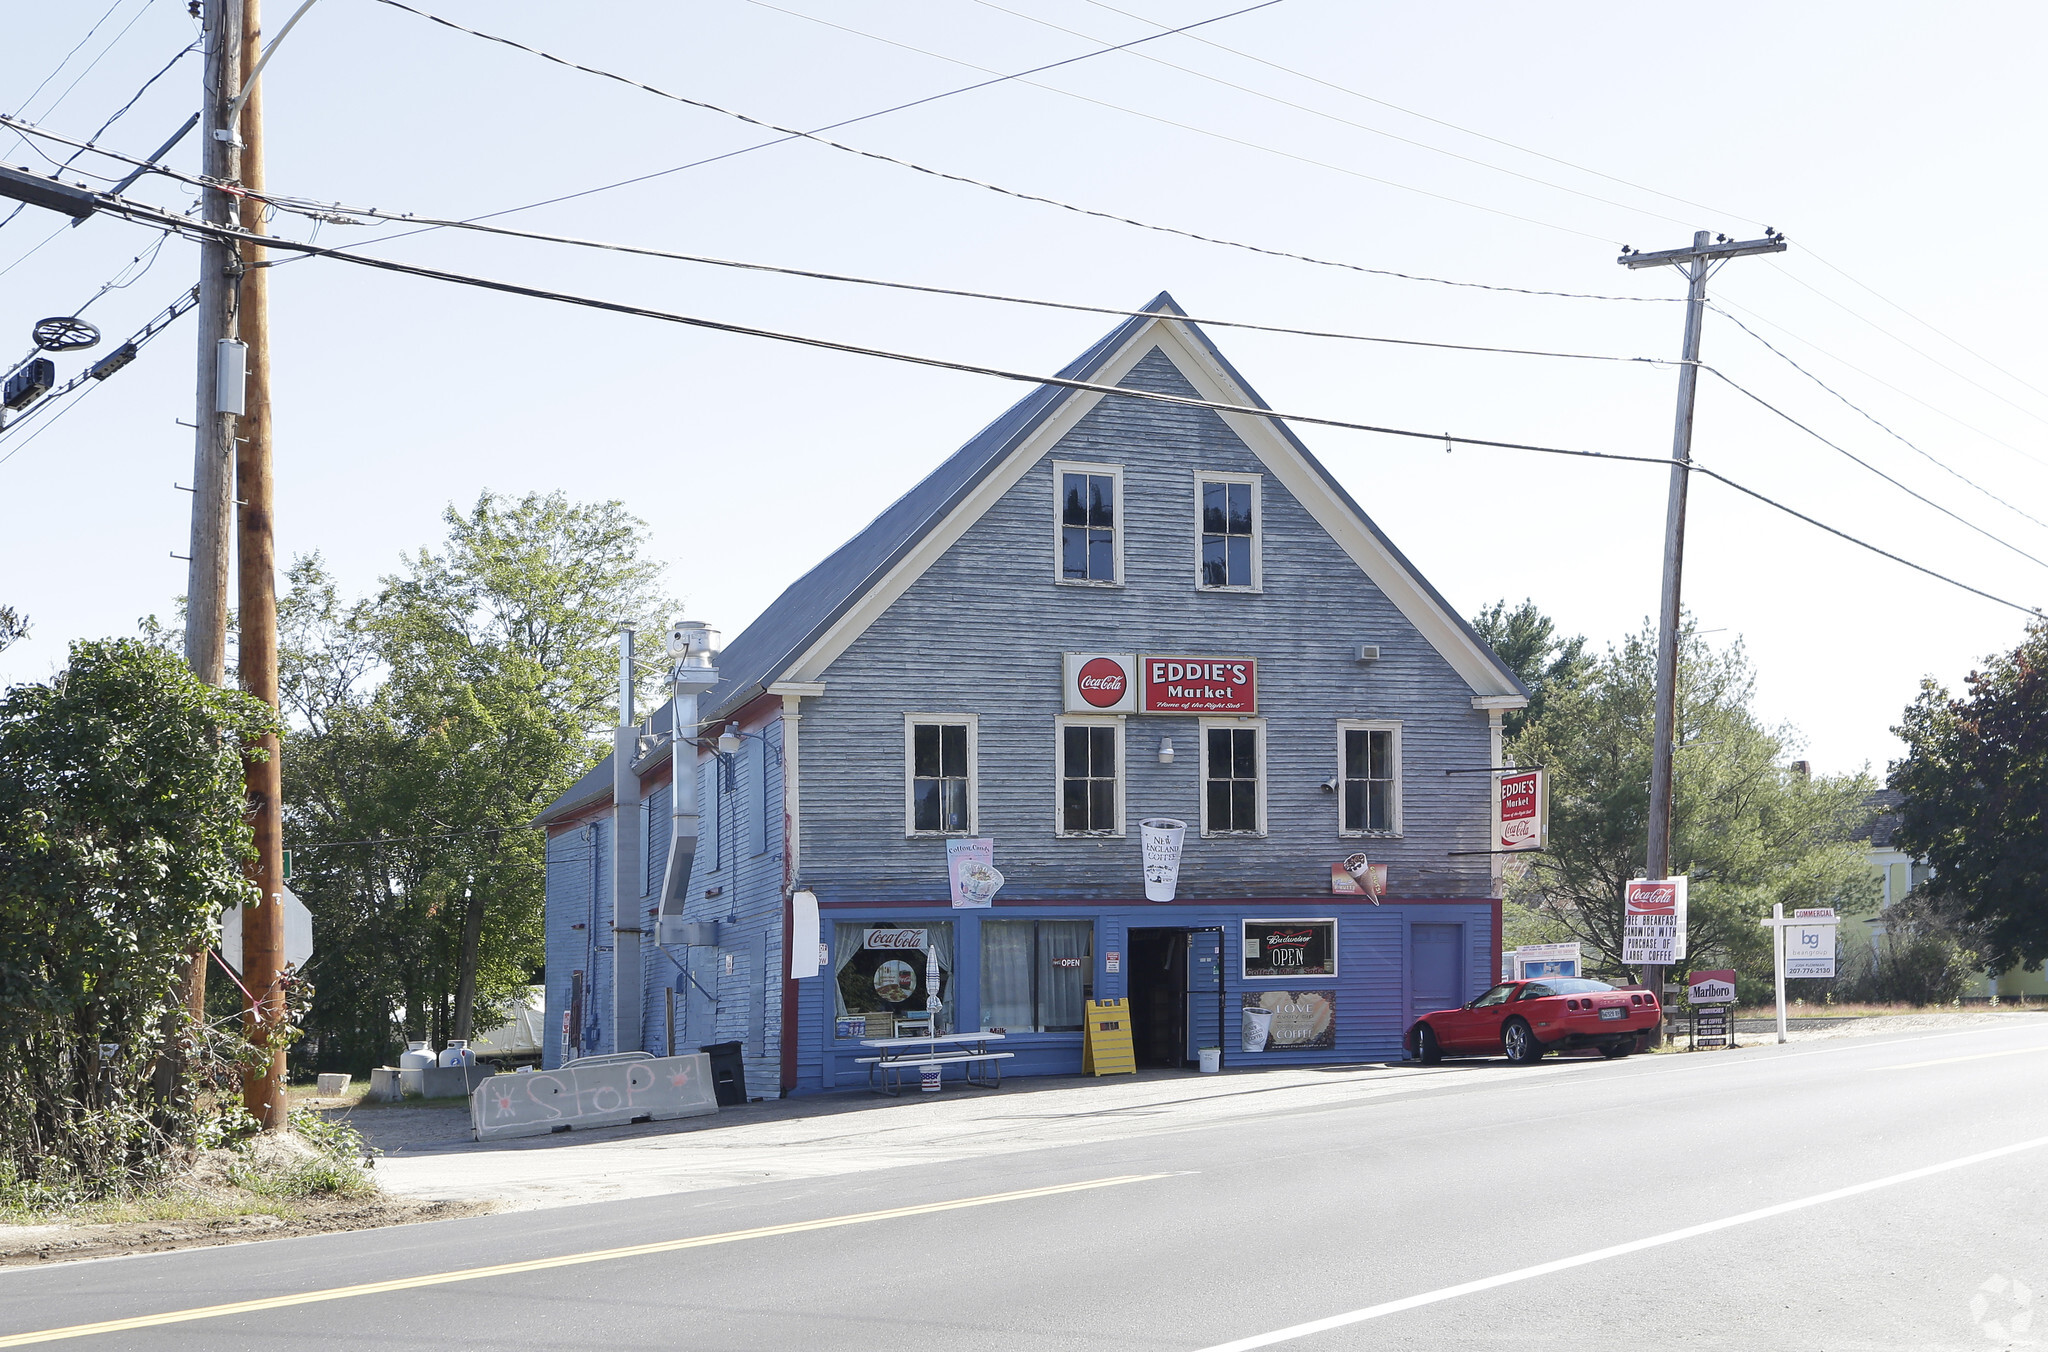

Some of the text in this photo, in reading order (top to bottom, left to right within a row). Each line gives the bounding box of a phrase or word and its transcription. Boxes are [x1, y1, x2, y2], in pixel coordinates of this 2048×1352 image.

[1152, 662, 1247, 685] EDDIE'S
[1081, 674, 1124, 691] Coca-Cola
[1168, 685, 1233, 699] Market
[1502, 780, 1535, 800] EDDIE'S
[1506, 797, 1529, 808] Market
[1504, 820, 1530, 839] Coca-Cola
[1153, 836, 1171, 845] NEW
[948, 845, 972, 854] Cotton
[1146, 842, 1179, 853] ENGLAND
[1147, 852, 1178, 861] COFFEE
[1630, 888, 1674, 903] Coca-Cola
[1796, 910, 1833, 918] COMMERCIAL
[1624, 915, 1677, 925] FREE BREAKFAST
[1624, 927, 1677, 937] SANDWICH WITH
[867, 929, 924, 948] Coca-Cola
[1266, 935, 1312, 945] Budweiser
[1628, 938, 1671, 949] PURCHASE OF
[1801, 930, 1819, 949] bg
[1272, 947, 1304, 967] OPEN
[1625, 950, 1672, 960] LARGE COFFEE
[1061, 959, 1080, 967] OPEN
[1693, 984, 1730, 998] Marlboro
[1276, 1003, 1313, 1013] LOVE
[988, 1026, 1008, 1034] Milk
[1276, 1029, 1312, 1039] COFFEE
